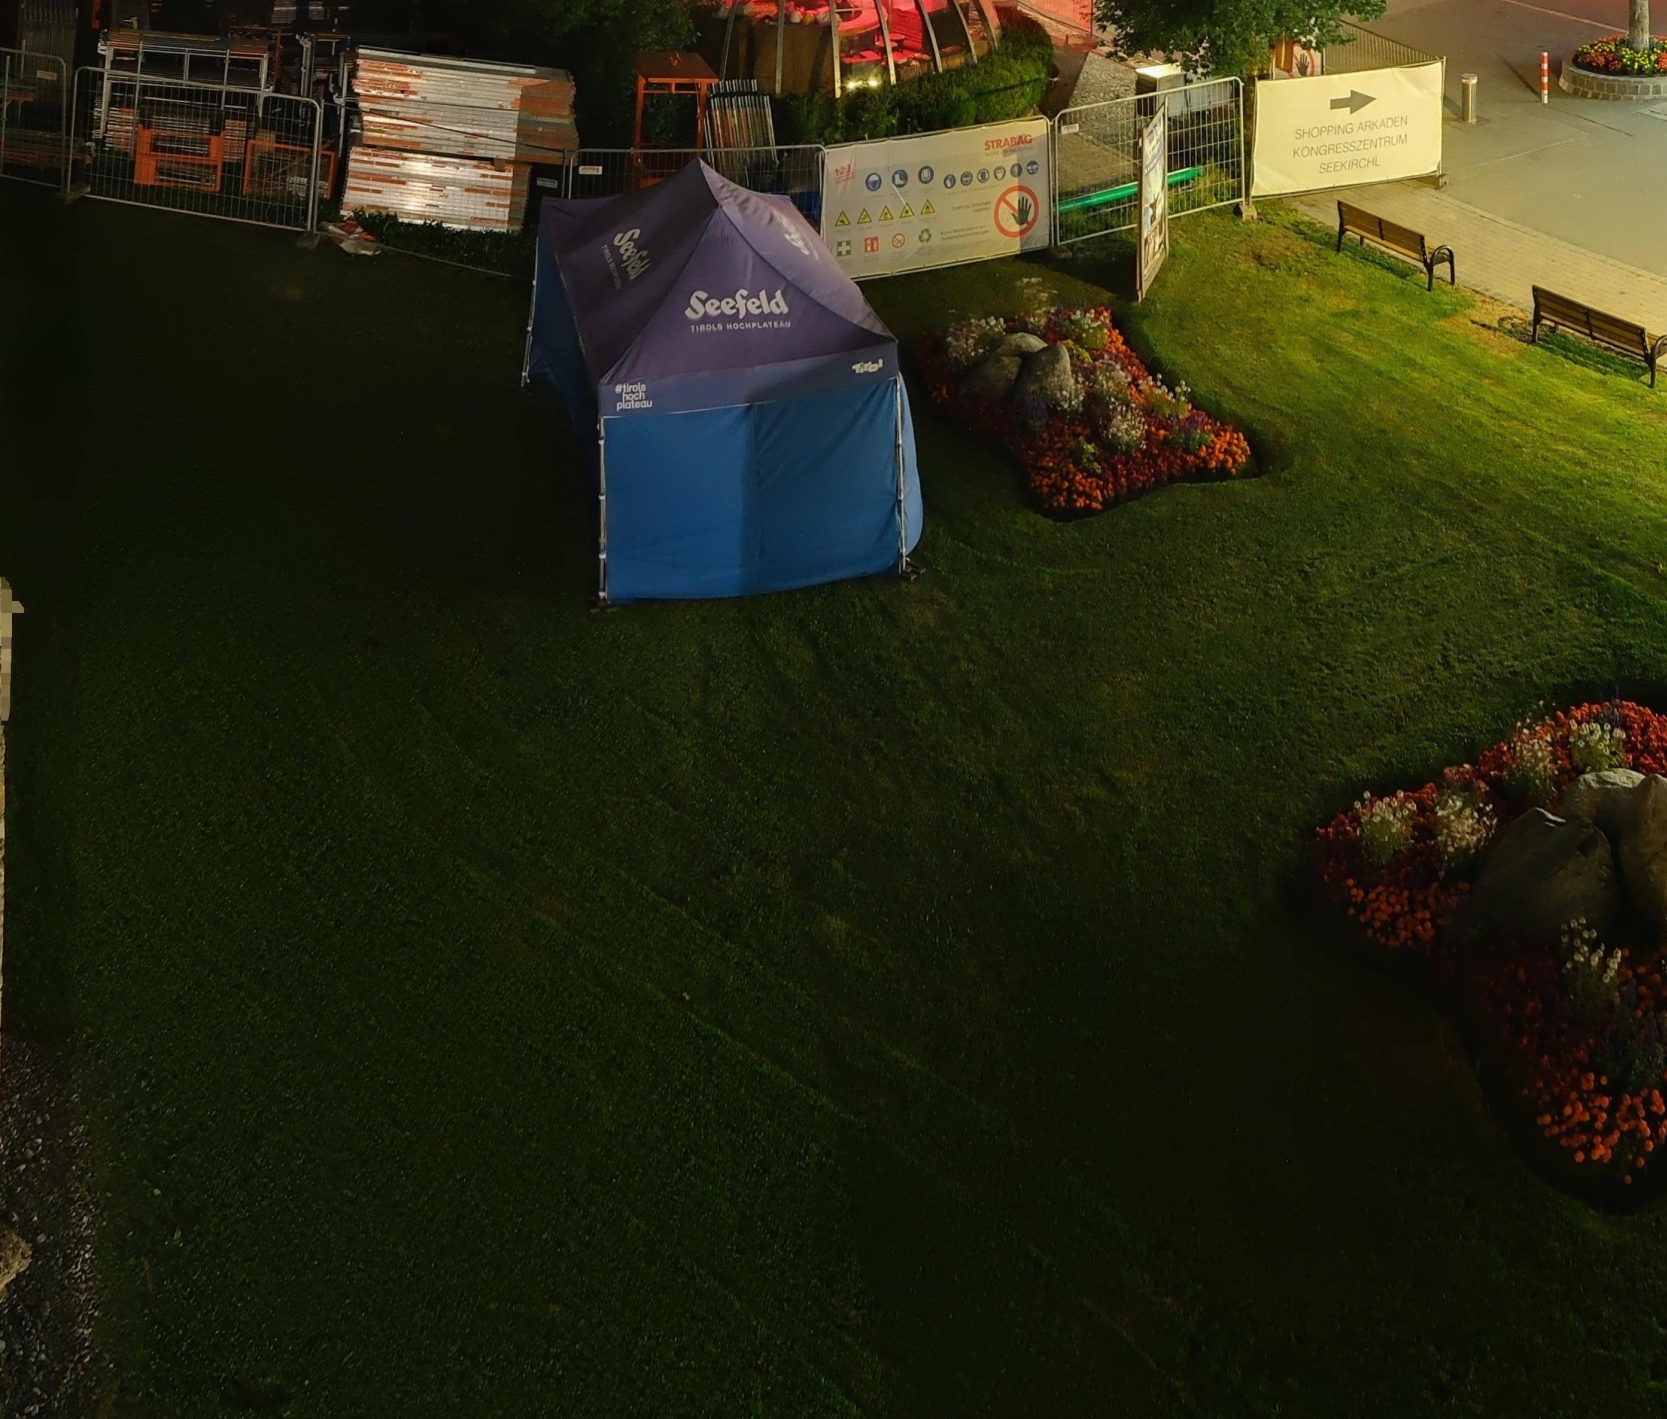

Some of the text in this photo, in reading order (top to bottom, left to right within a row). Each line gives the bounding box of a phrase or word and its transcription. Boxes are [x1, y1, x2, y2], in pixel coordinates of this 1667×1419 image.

[1294, 115, 1409, 141] SHOPPING ARKADEN
[984, 133, 1034, 151] STRABAG
[1292, 133, 1409, 159] KONGRESSZENTRUM
[1318, 156, 1381, 175] SEEKIRCHL
[684, 288, 790, 320] Seefeld
[690, 320, 792, 333] TIROLS HOCHPLATEAU
[614, 381, 647, 393] #tirols
[622, 390, 646, 401] hoch
[616, 398, 653, 411] plateau
